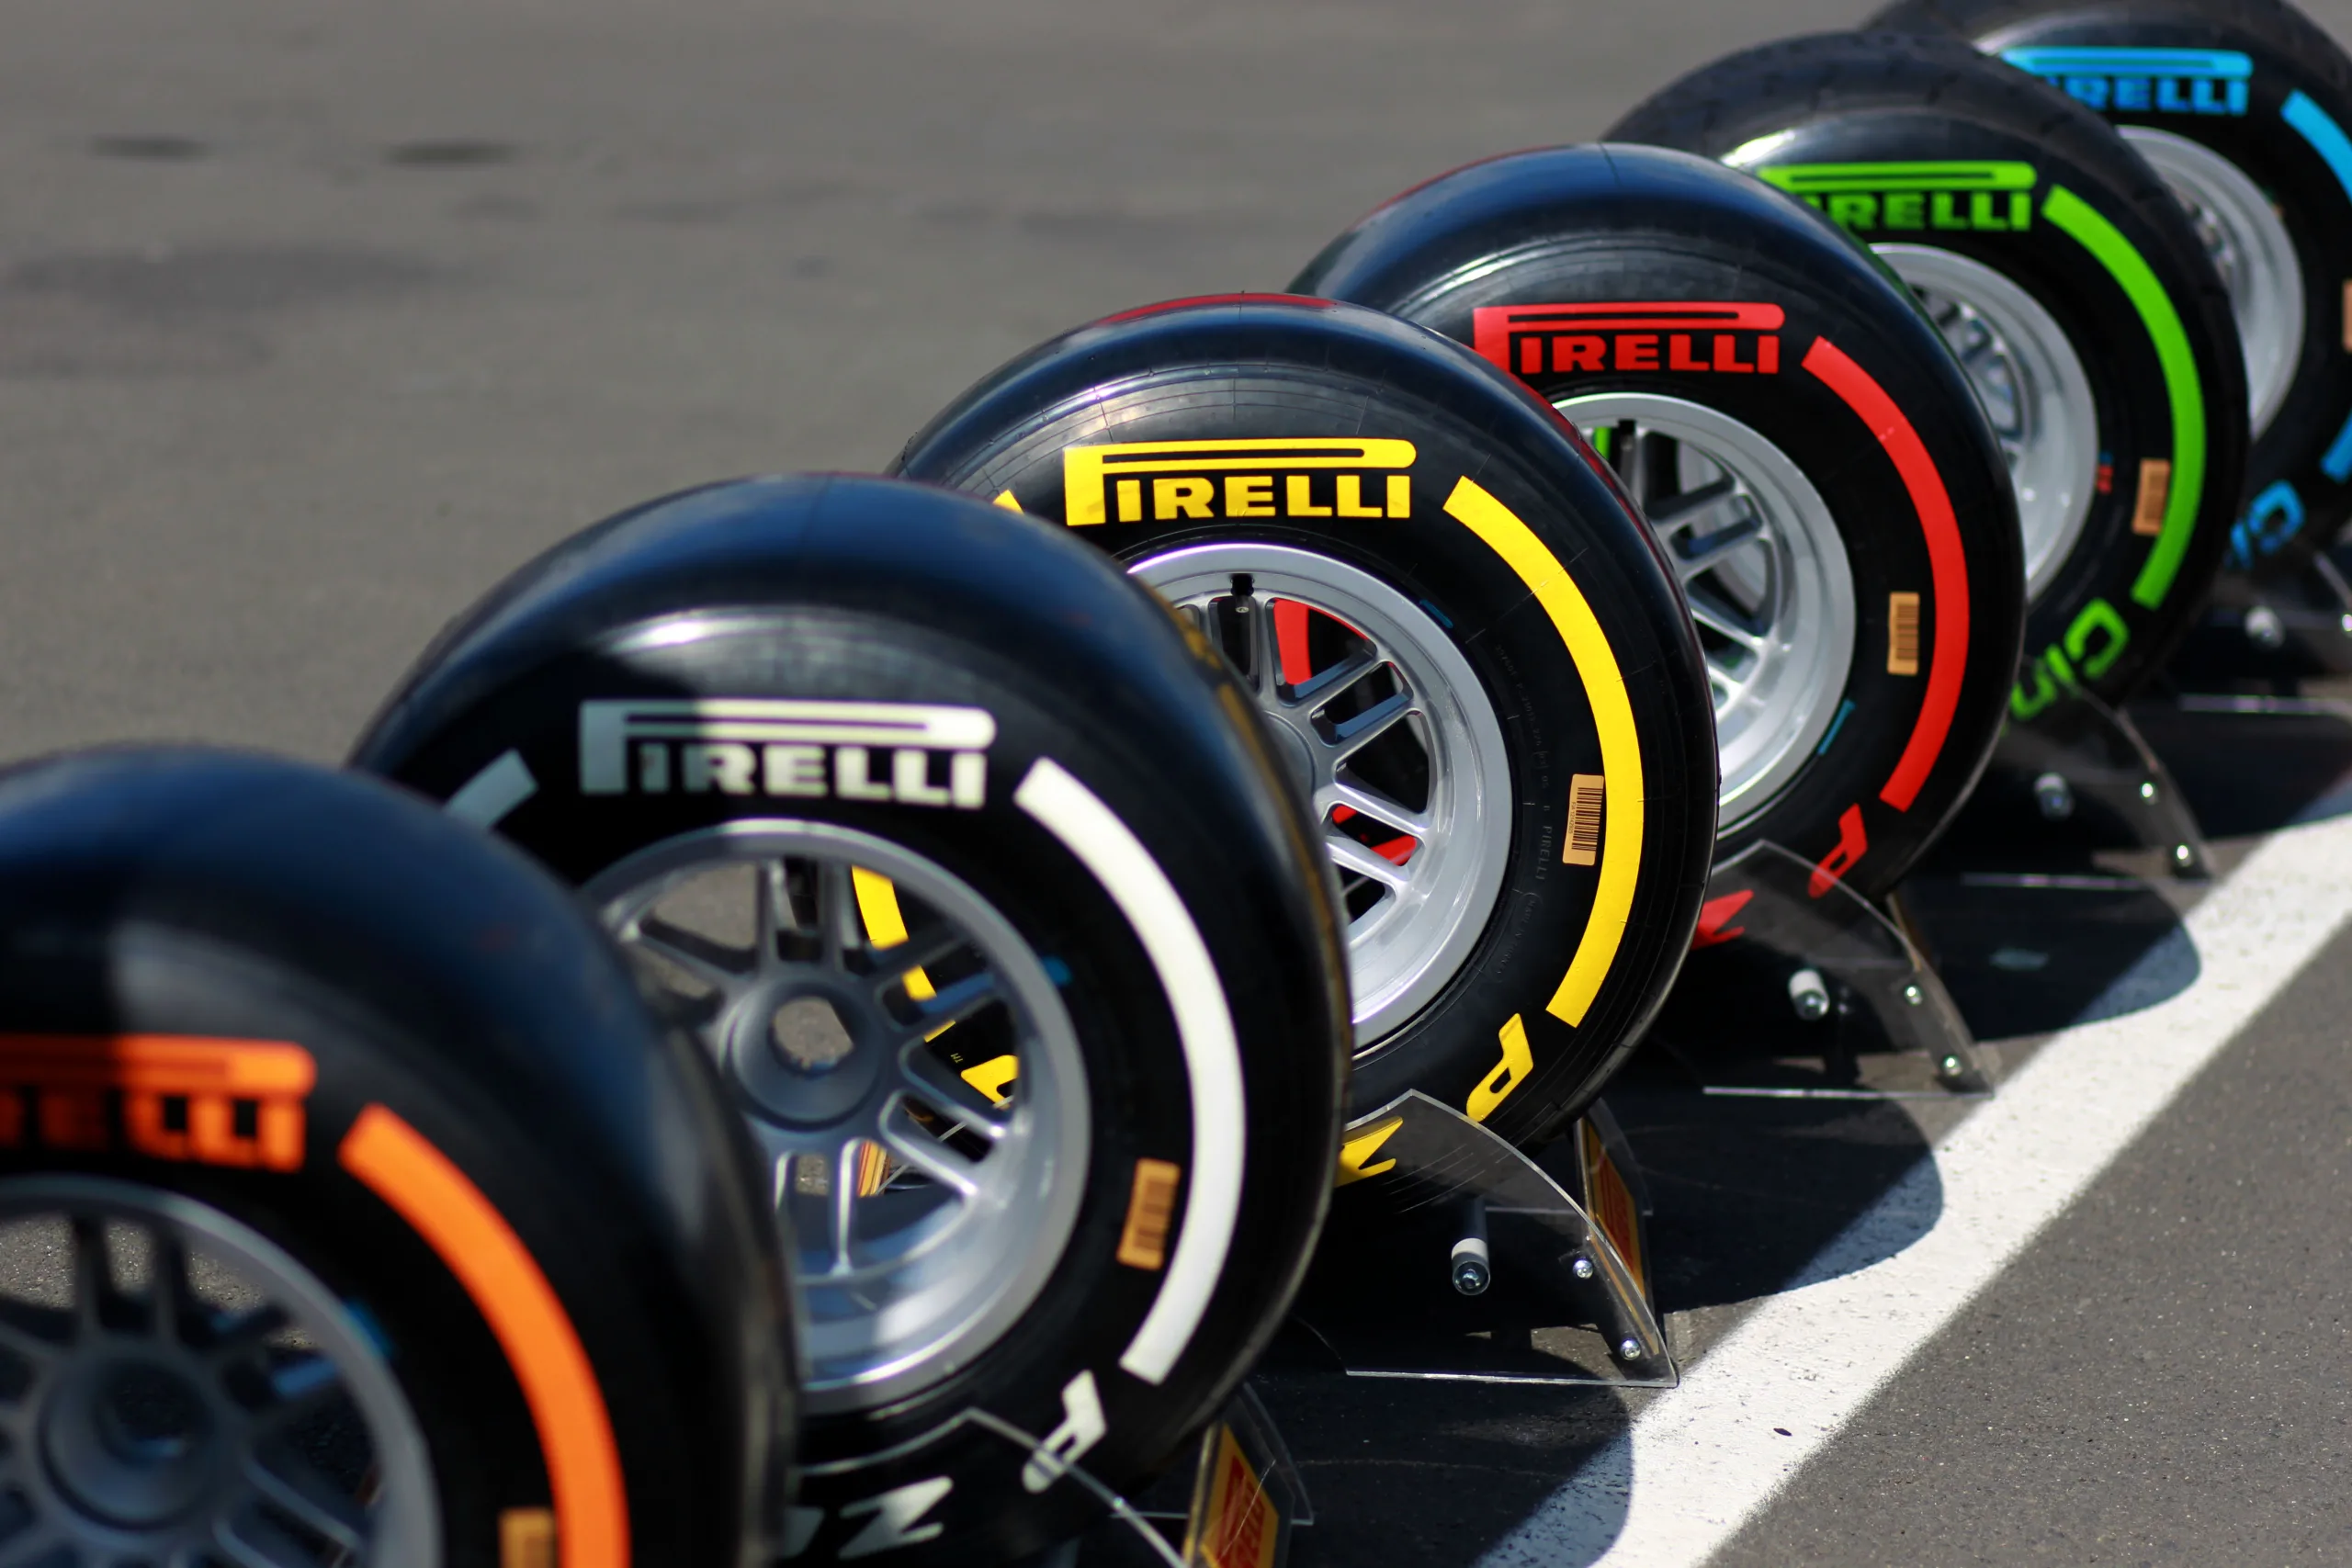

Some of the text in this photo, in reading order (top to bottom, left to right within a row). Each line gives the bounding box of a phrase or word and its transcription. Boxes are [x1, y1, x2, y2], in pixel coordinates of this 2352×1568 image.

[1999, 47, 2253, 117] PRELLI
[1755, 161, 2037, 231] PRELLI
[1474, 301, 1785, 374] PIRELLI
[1064, 437, 1417, 526] PIRELLI
[579, 698, 996, 808] PIRELLI
